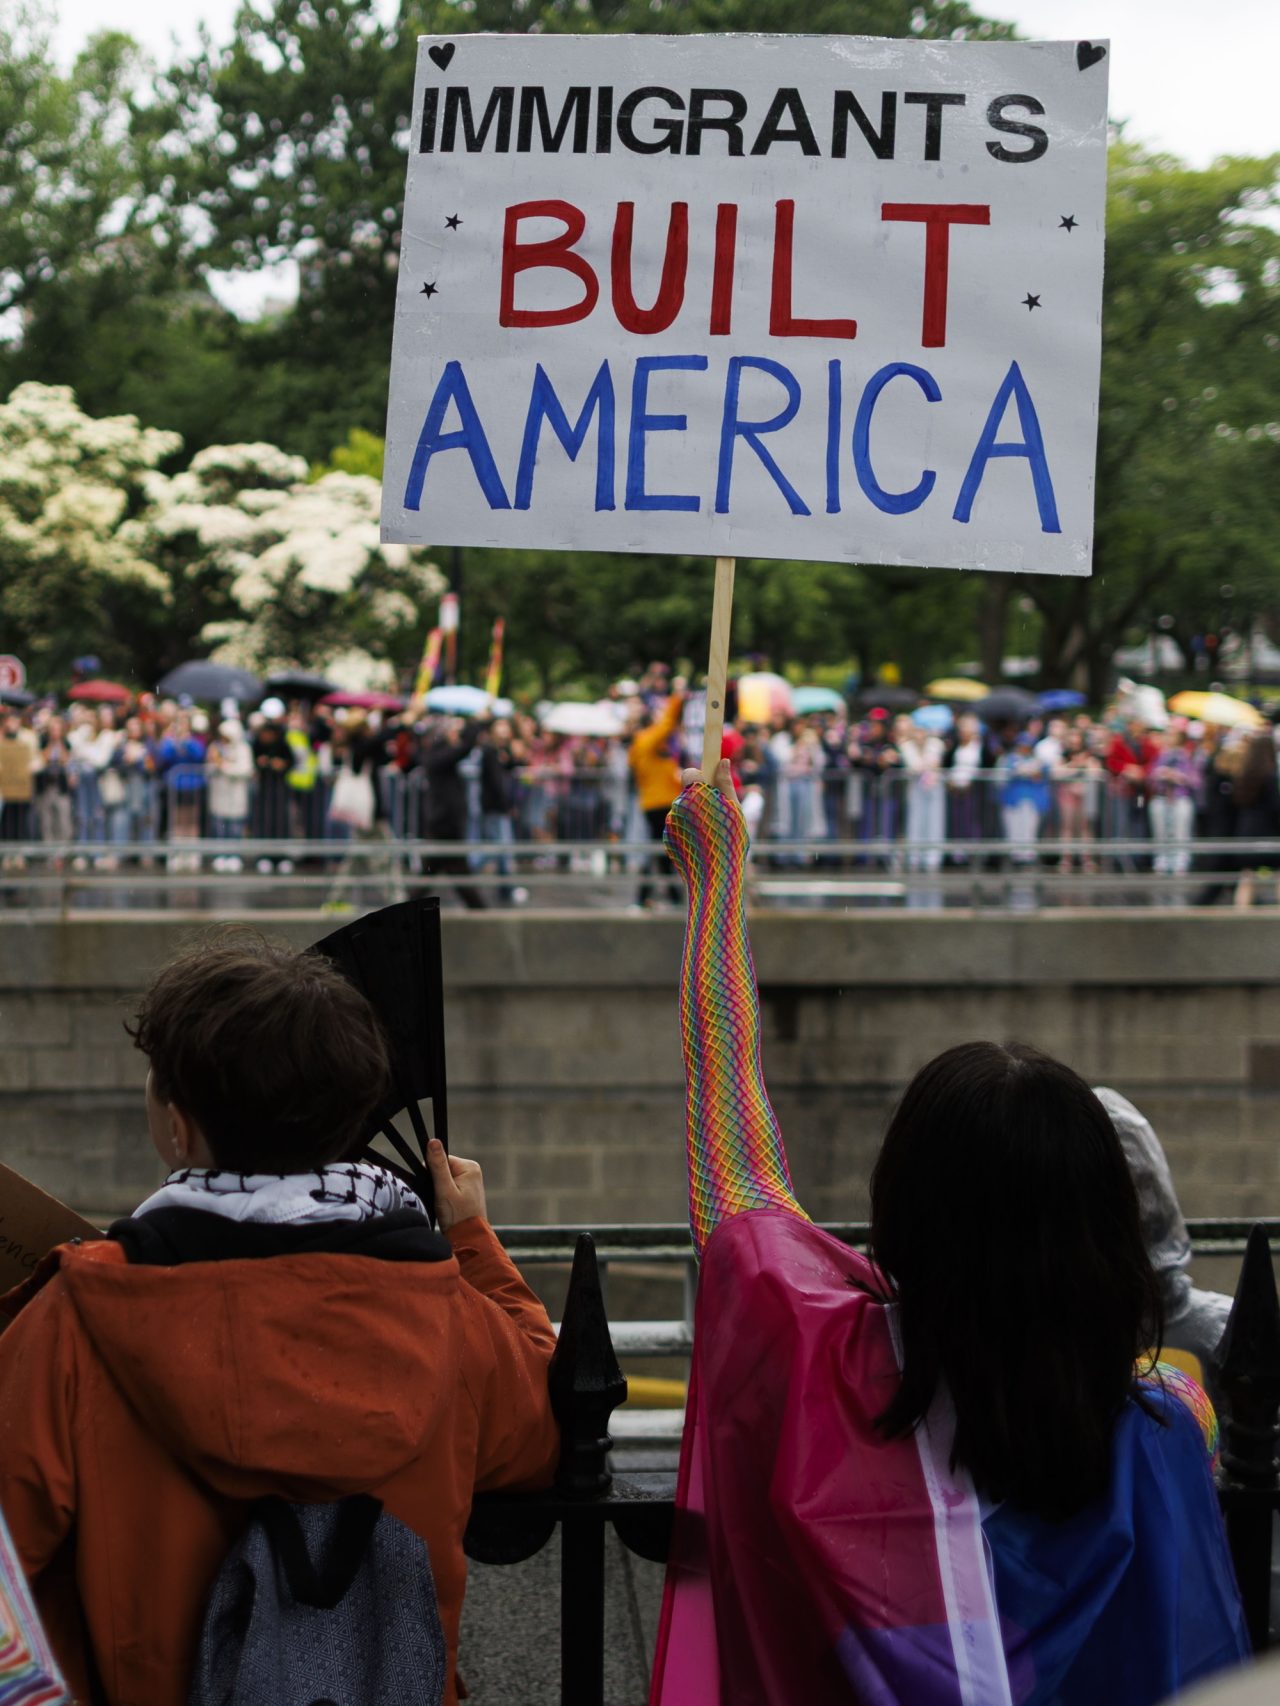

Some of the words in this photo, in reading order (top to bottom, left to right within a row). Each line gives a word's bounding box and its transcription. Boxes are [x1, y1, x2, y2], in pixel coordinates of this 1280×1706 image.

[419, 86, 1049, 163] IMMIGRANTS
[499, 199, 991, 348] BUILT
[404, 354, 1062, 533] AMERICA
